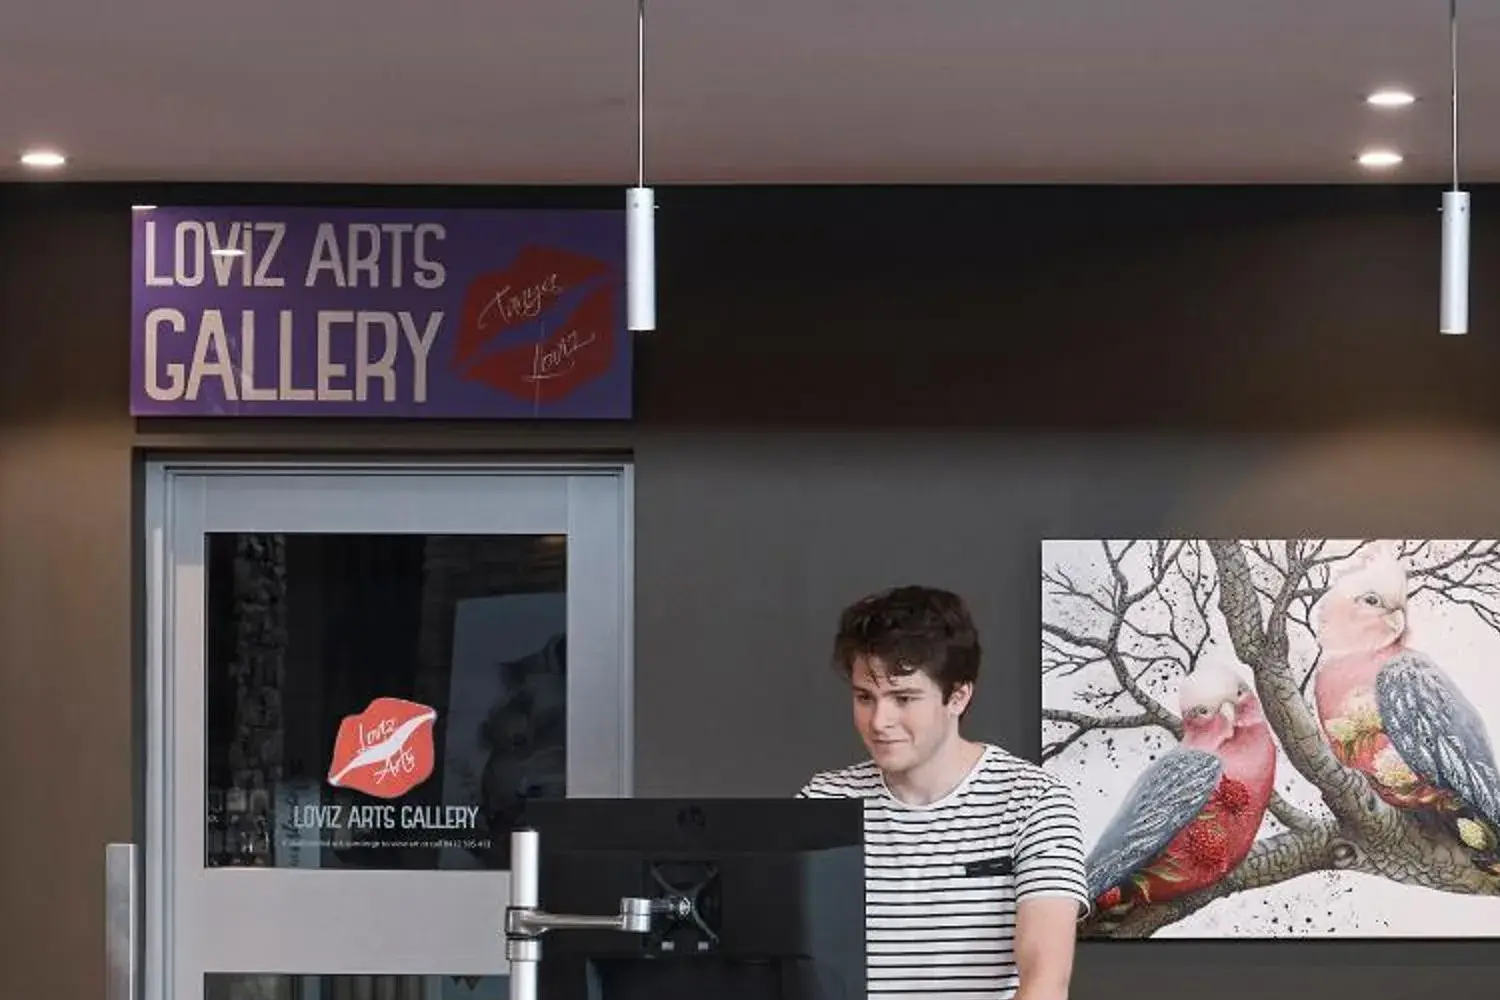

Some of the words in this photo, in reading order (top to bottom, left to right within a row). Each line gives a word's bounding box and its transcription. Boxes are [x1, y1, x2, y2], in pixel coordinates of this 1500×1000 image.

[305, 222, 447, 289] ARTS
[145, 309, 444, 403] GALLERY
[346, 804, 396, 829] ARTS
[400, 804, 480, 829] GALLERY
